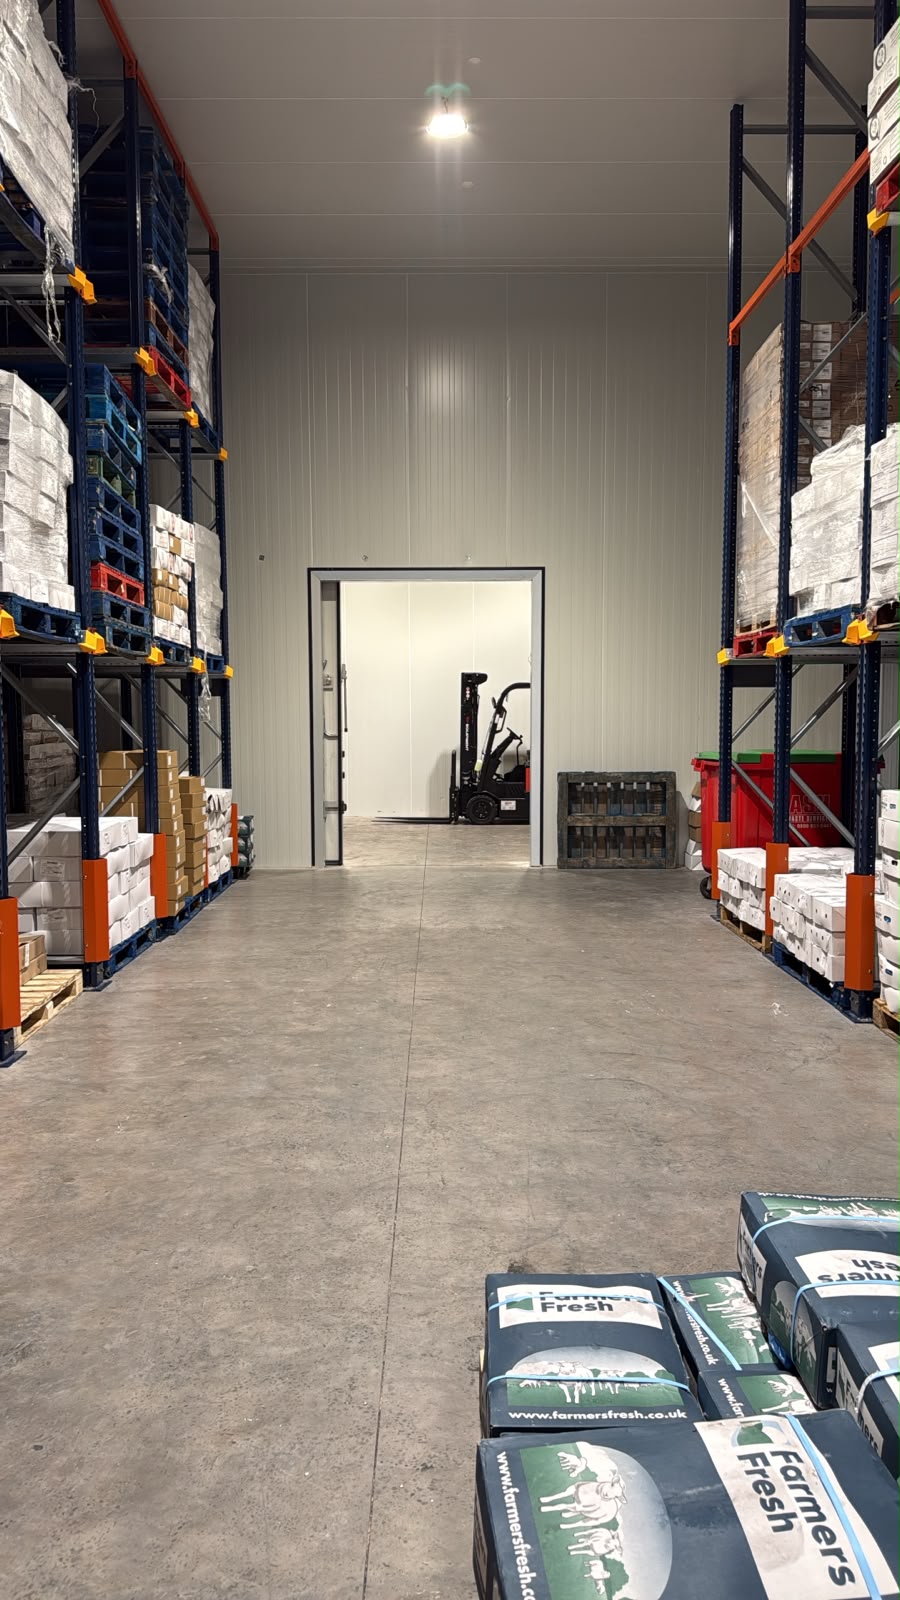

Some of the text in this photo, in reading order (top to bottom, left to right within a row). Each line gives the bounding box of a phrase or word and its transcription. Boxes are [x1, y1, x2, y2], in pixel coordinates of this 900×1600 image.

[540, 1301, 614, 1313] Fresh
[508, 1408, 688, 1421] www.farmersfresh.co.uk
[717, 1378, 745, 1418] www.far
[736, 1452, 798, 1533] Fresh
[769, 1450, 856, 1587] Farmers
